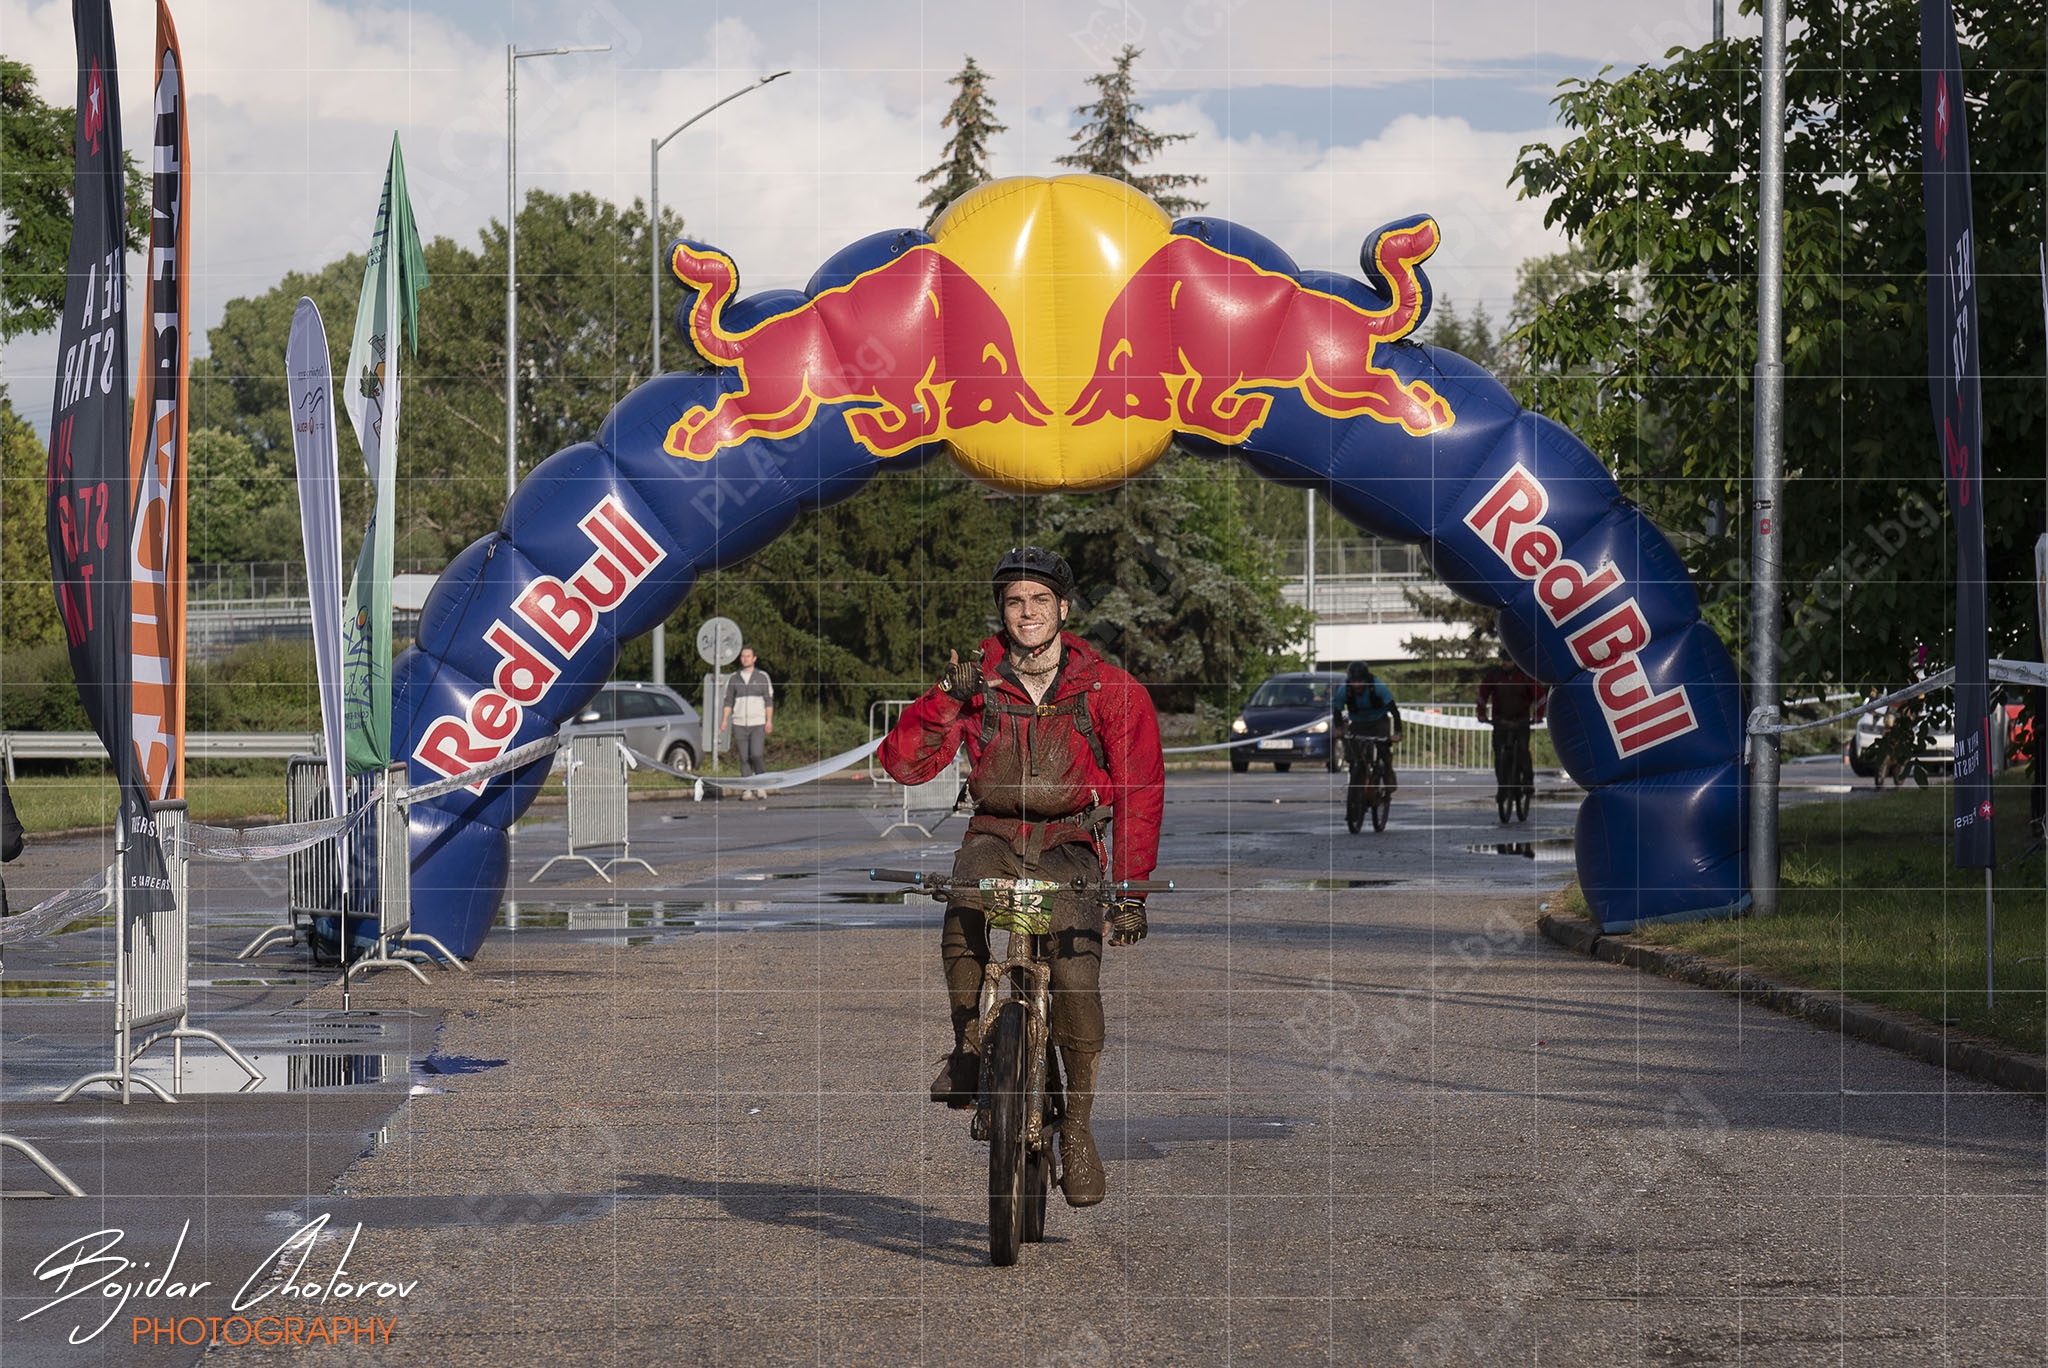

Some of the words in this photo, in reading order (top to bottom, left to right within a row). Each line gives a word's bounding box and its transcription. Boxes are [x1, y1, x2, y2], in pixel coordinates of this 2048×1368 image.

[412, 619, 562, 797] Red
[510, 493, 668, 660] Bull
[1462, 461, 1625, 628] Red
[1564, 597, 1699, 760] Bull
